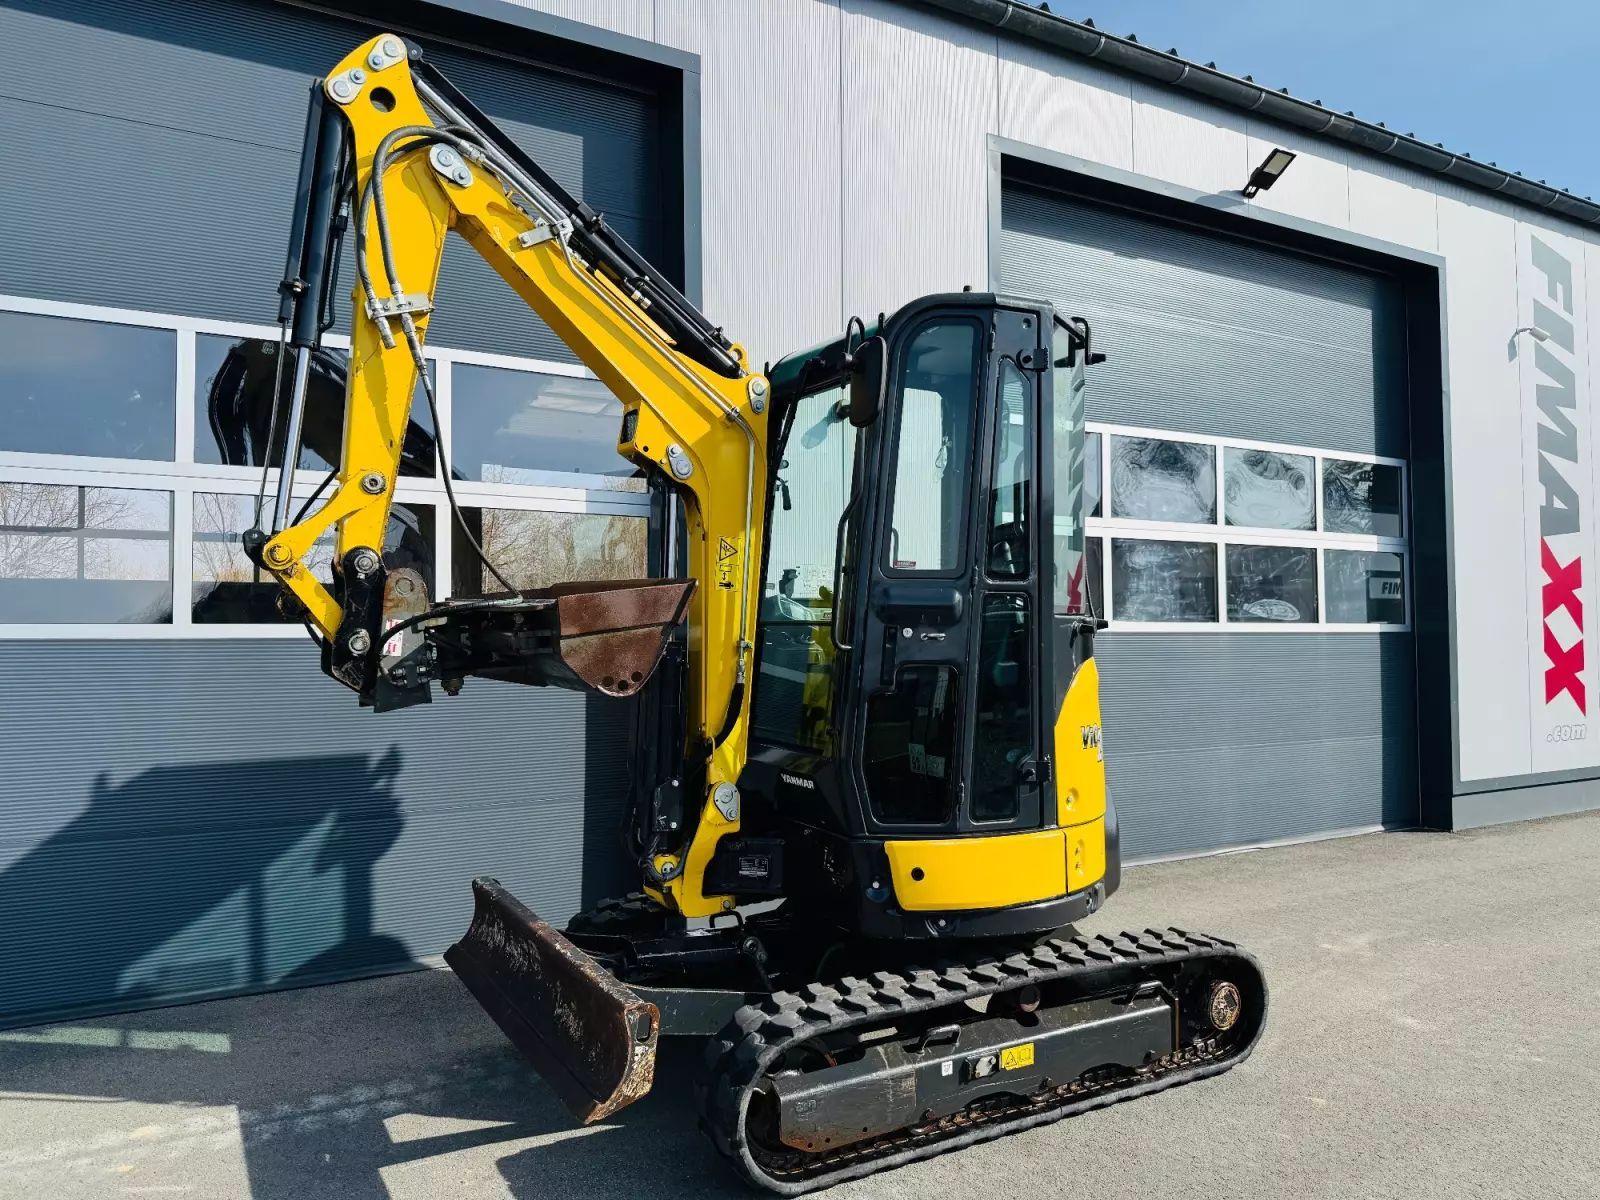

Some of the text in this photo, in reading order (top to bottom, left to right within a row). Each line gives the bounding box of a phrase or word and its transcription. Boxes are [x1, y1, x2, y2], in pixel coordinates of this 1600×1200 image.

[1530, 232, 1587, 717] FIMAXX
[1546, 723, 1587, 743] .com
[780, 772, 815, 790] YANMAR
